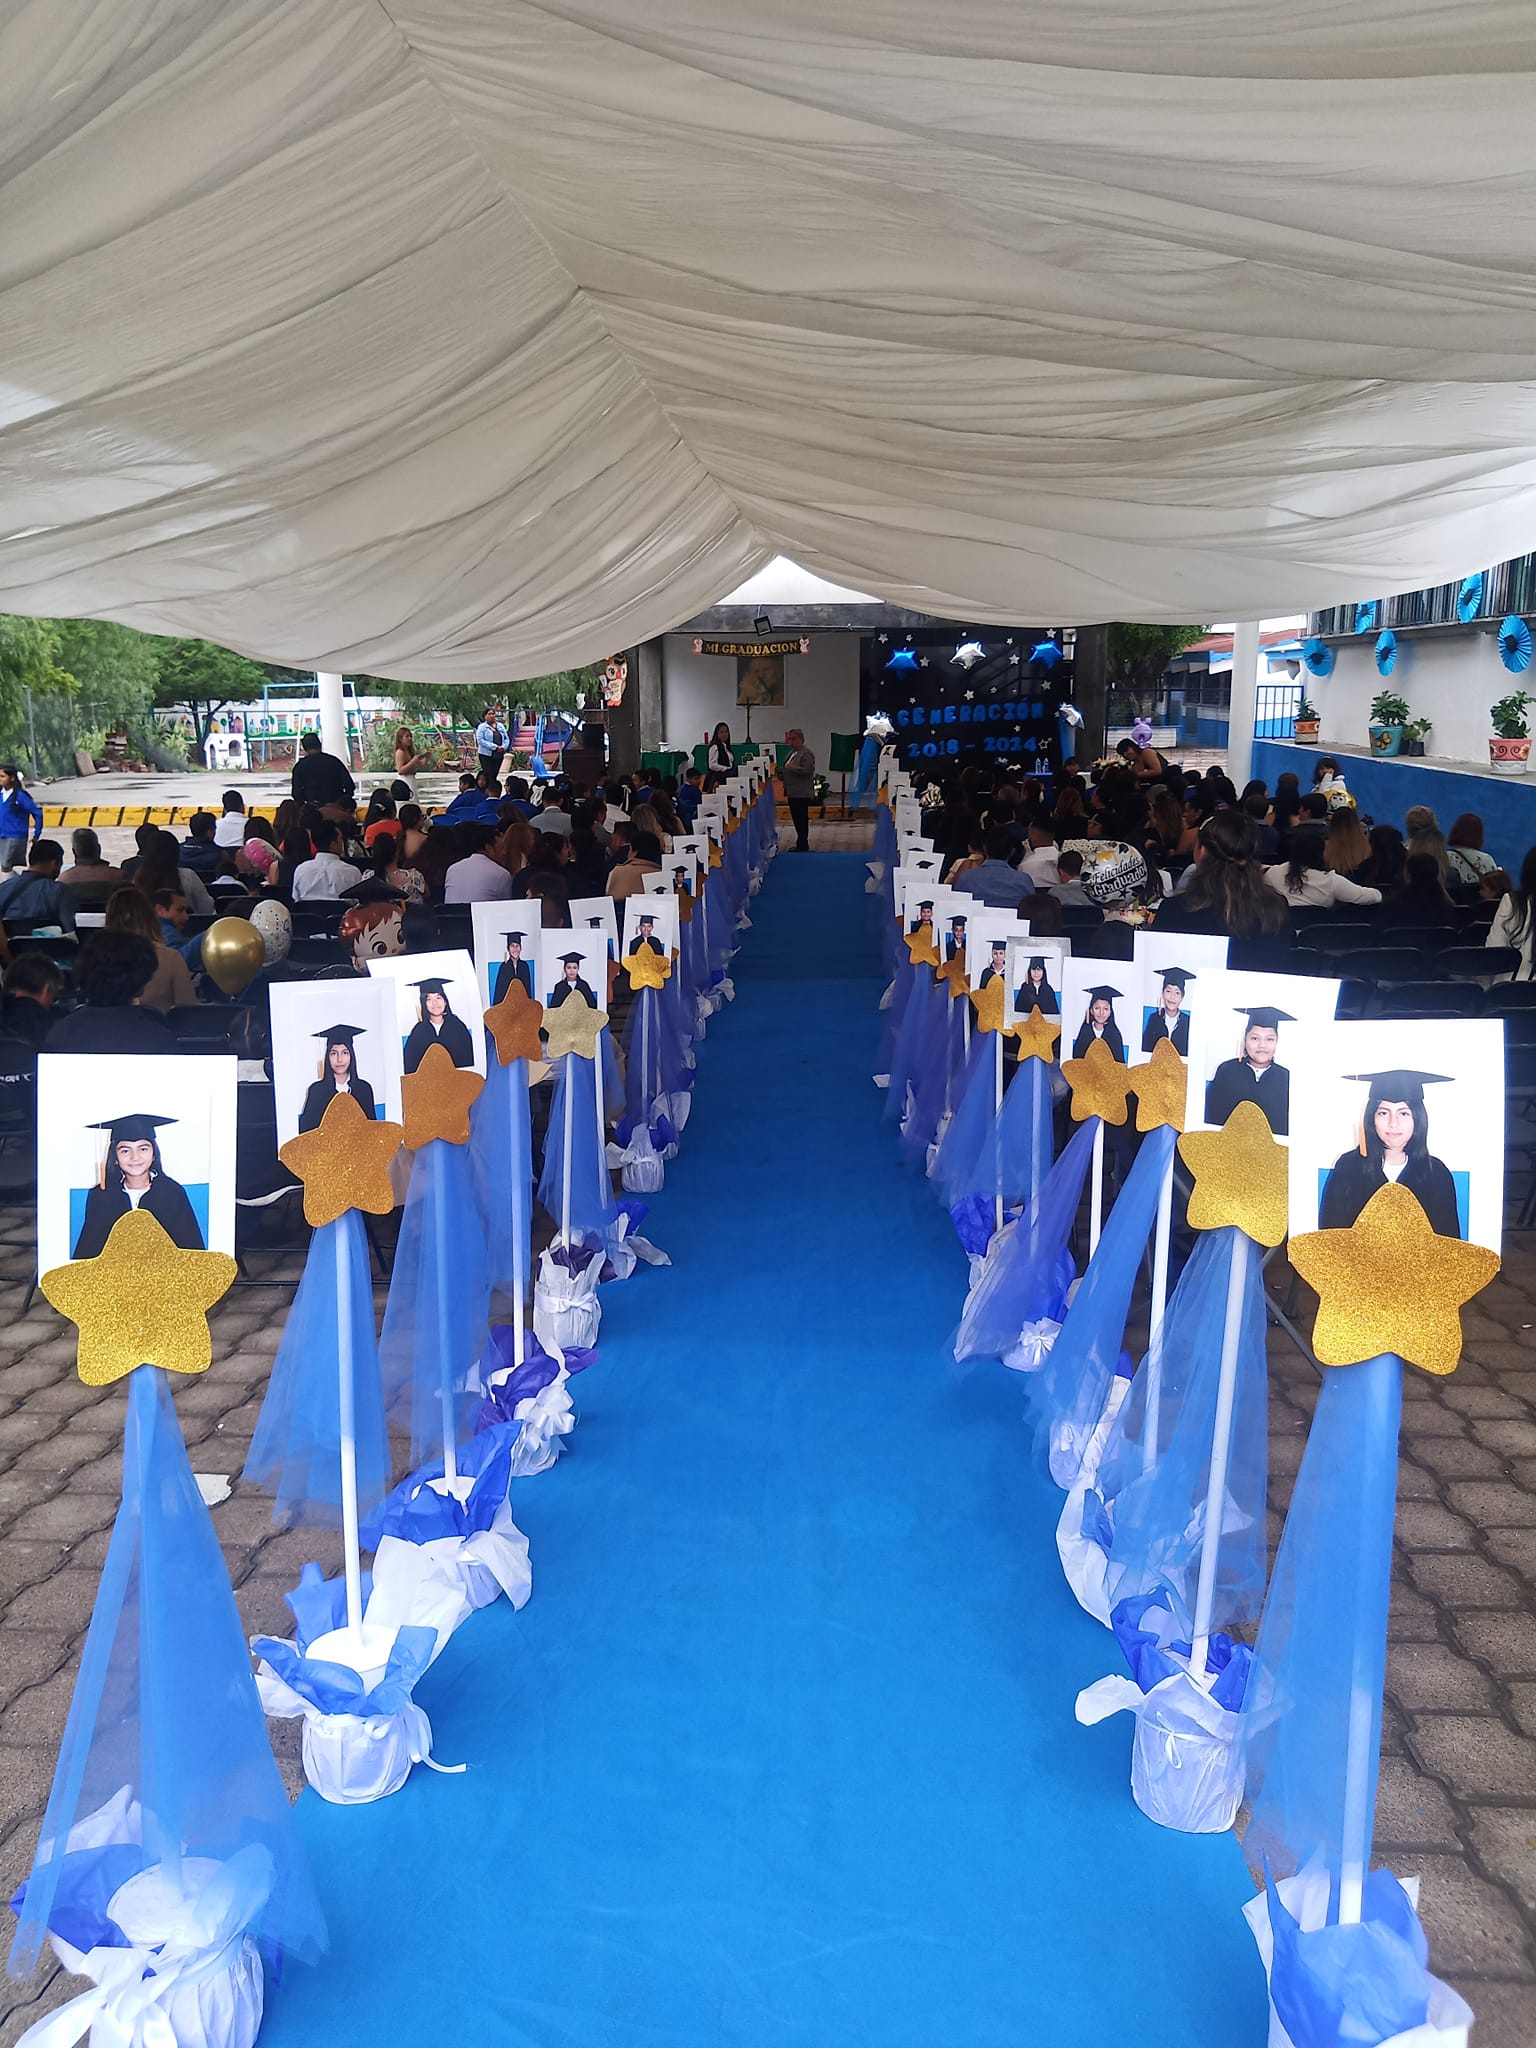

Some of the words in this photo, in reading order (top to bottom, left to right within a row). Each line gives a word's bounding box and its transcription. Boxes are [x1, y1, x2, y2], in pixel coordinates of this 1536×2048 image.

[706, 643, 718, 653] MI
[721, 642, 798, 655] GRADUACION
[907, 739, 959, 758] 2018
[983, 736, 1037, 752] 2024
[1093, 856, 1140, 883] Felicidades
[1094, 865, 1146, 897] Graduado
